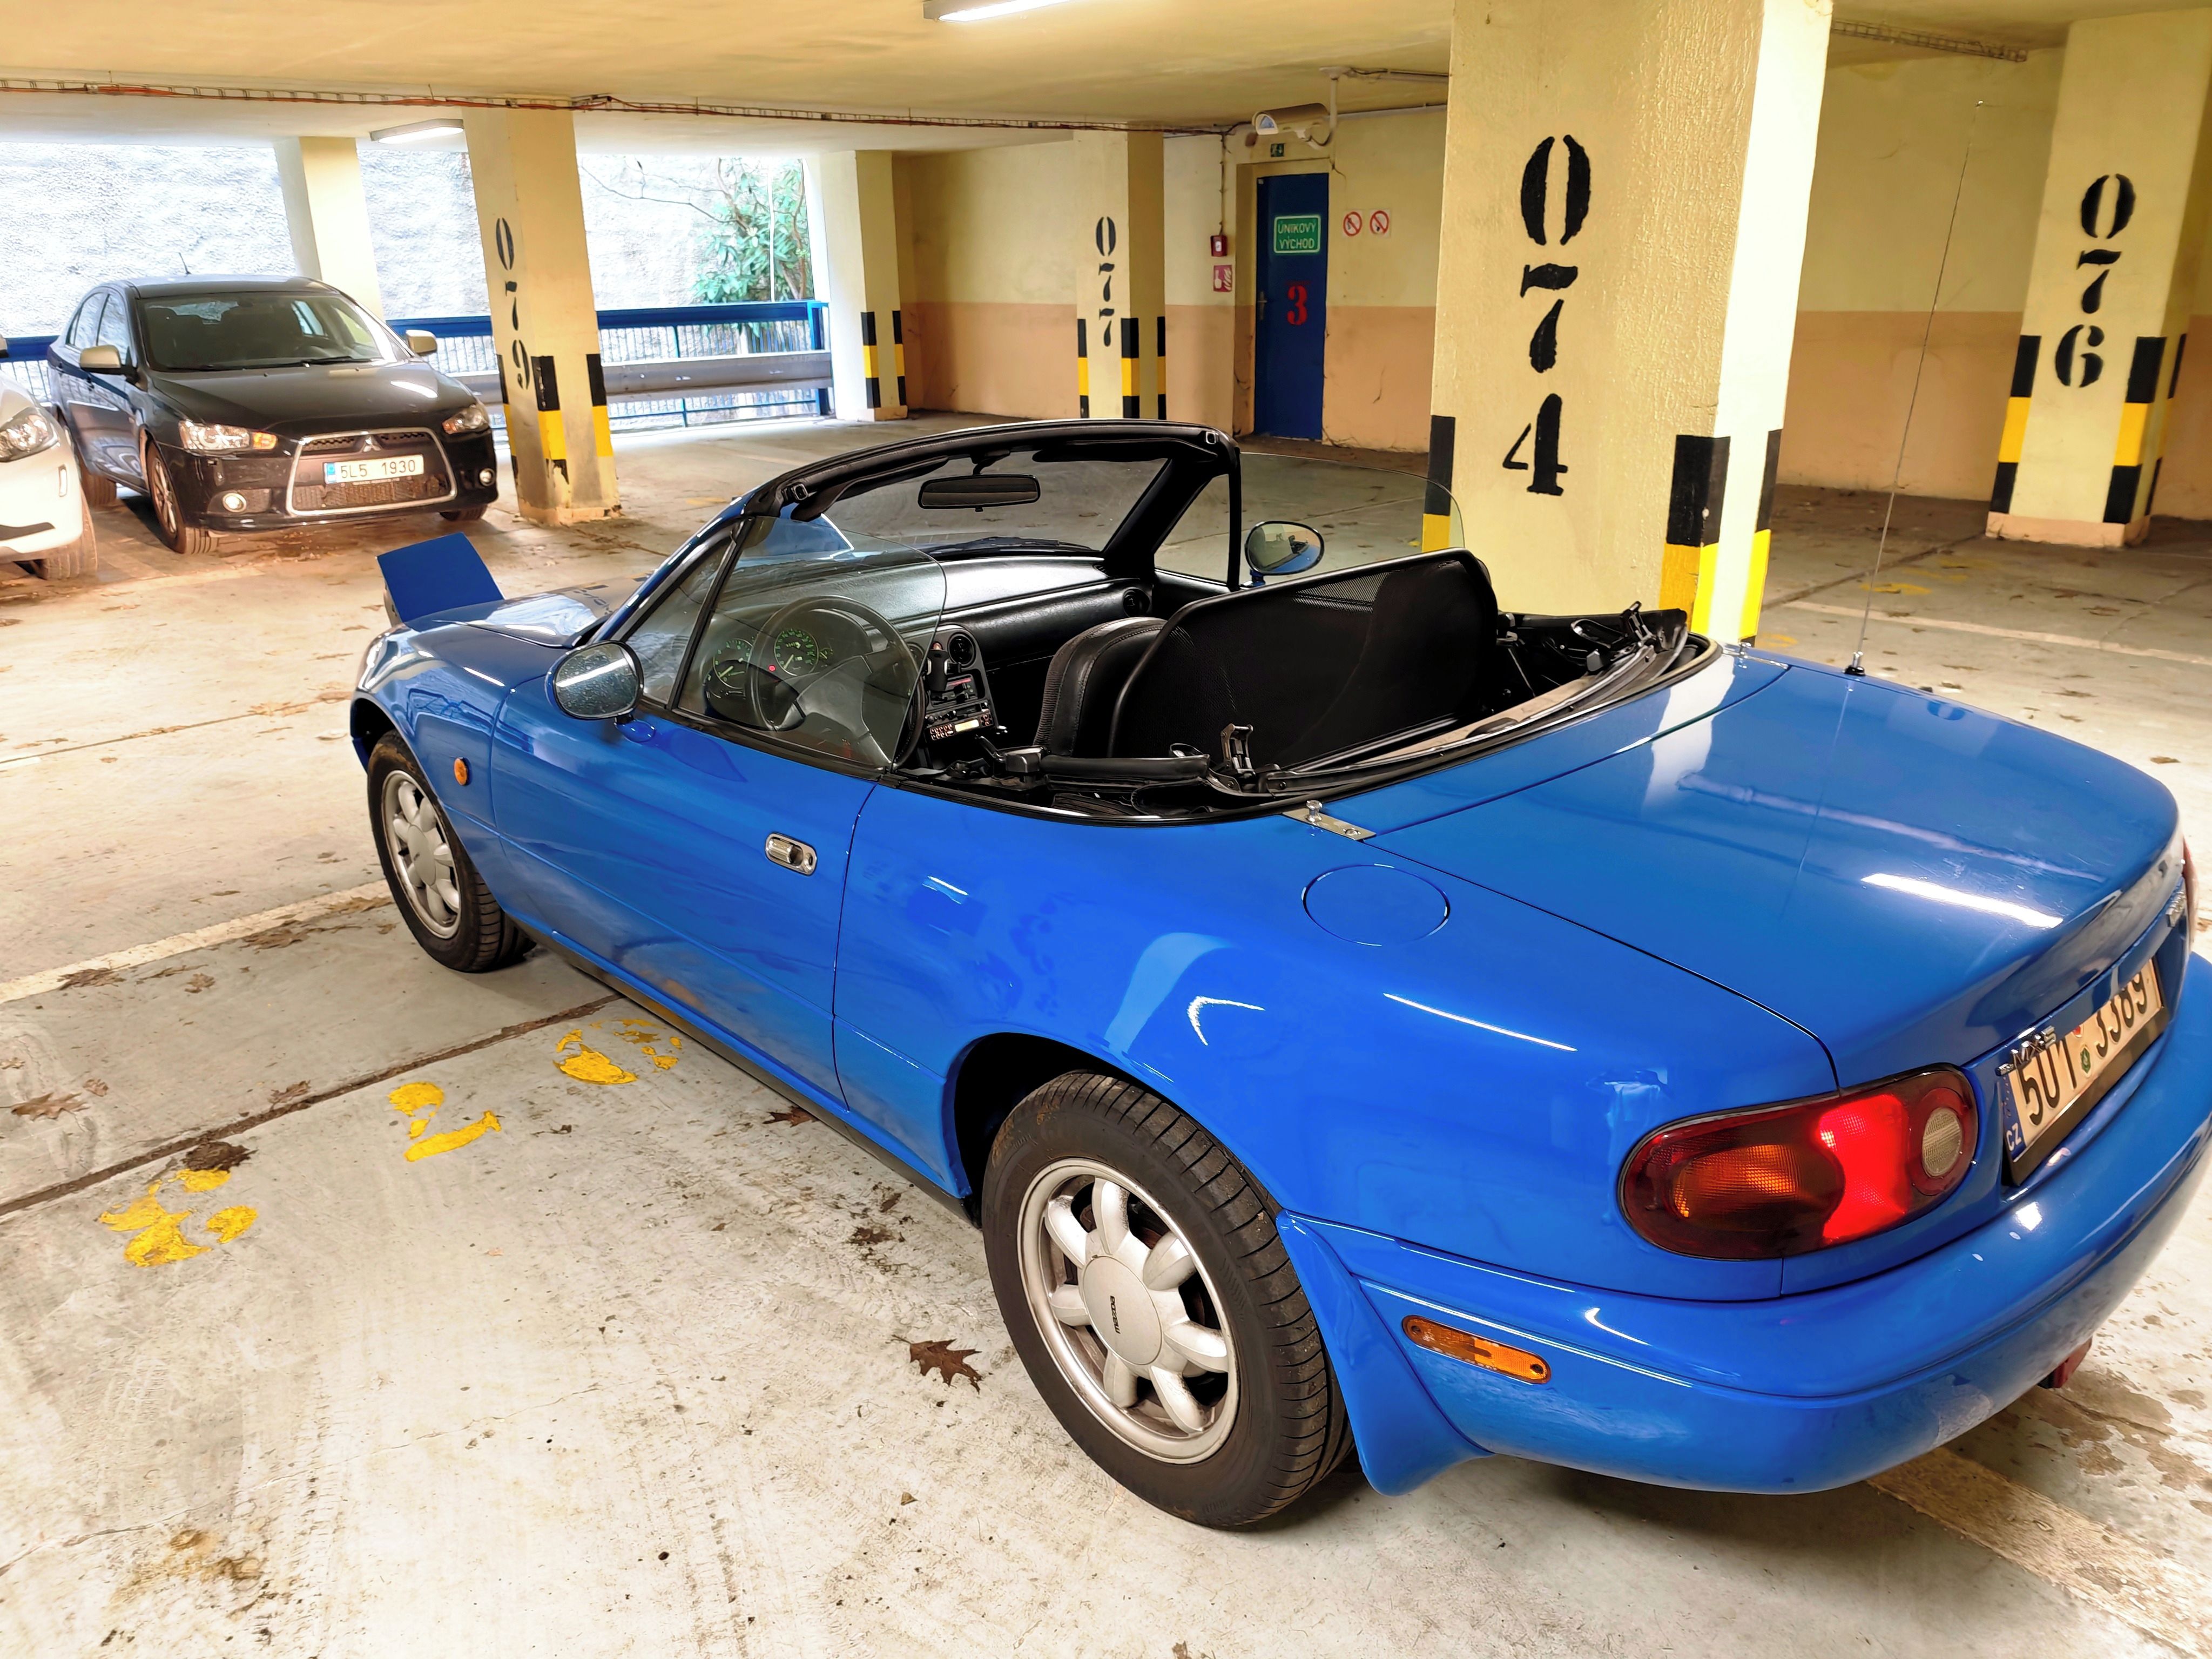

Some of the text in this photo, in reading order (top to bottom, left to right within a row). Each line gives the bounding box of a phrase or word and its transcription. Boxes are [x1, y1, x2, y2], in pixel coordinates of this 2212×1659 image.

[495, 217, 530, 390] 079
[1096, 217, 1116, 347] 077
[1287, 284, 1307, 326] 3
[1502, 134, 1590, 496] 074
[2055, 173, 2136, 388] 076
[341, 460, 415, 478] 5L5 1930
[2006, 1123, 2022, 1151] CZ
